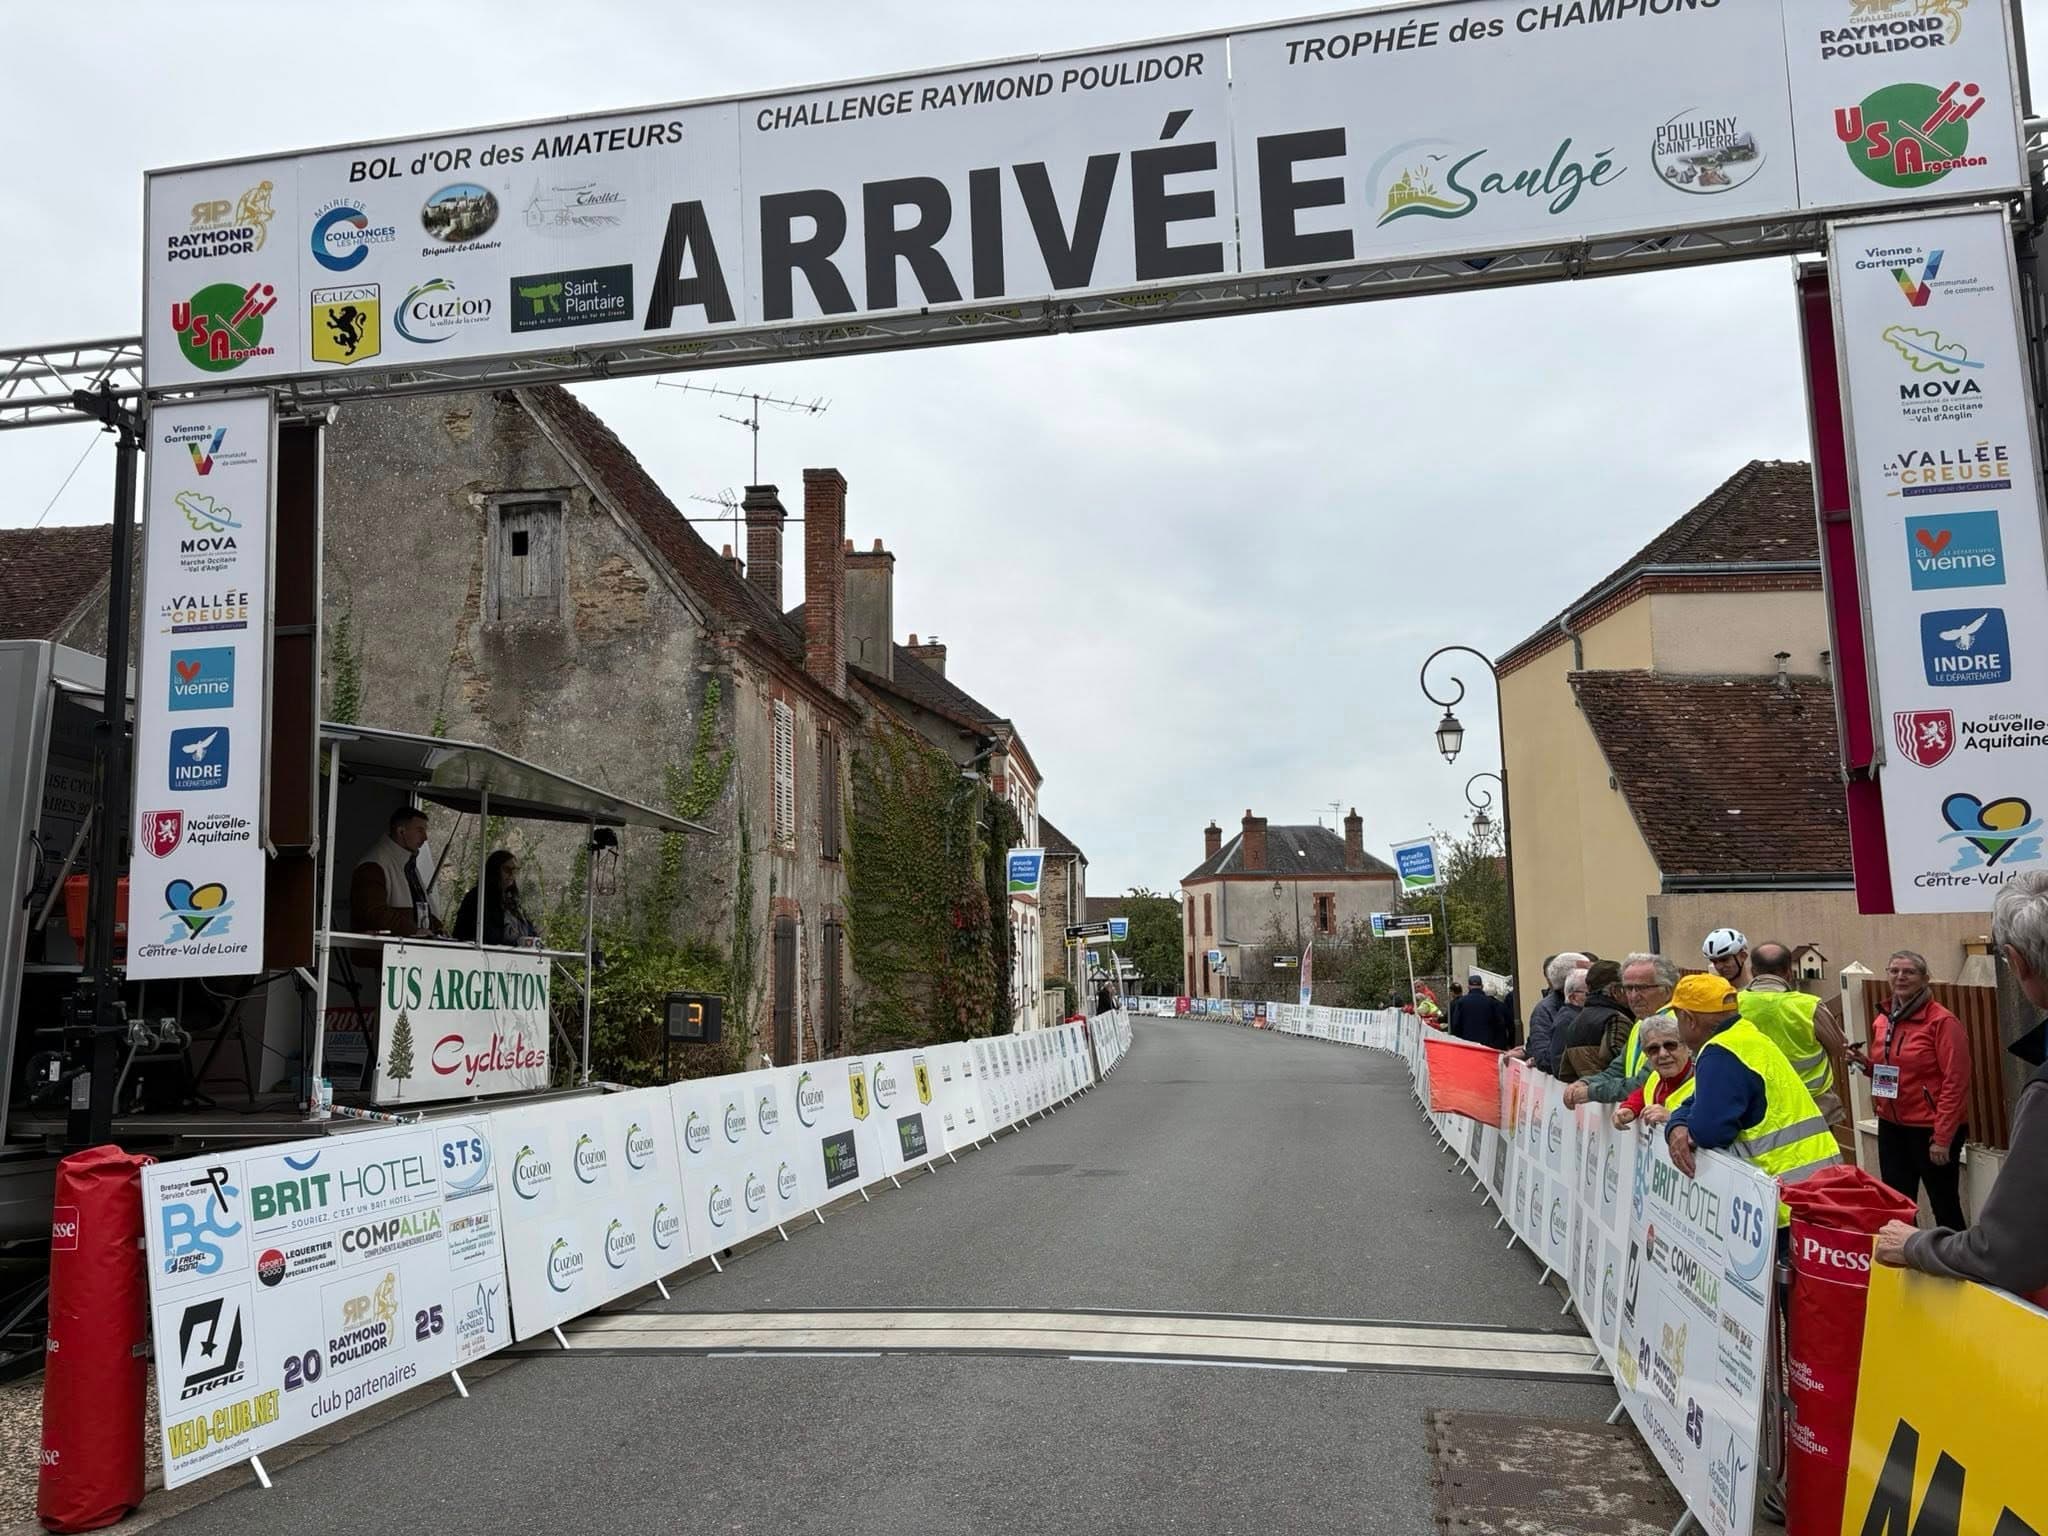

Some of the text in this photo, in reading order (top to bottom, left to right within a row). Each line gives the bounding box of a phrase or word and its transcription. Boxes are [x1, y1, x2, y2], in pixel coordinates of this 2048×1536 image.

[1285, 18, 1441, 65] TROPHÉE
[1448, 16, 1504, 44] des
[1820, 17, 1944, 44] RAYMOND
[1821, 34, 1945, 60] POULIDOR
[756, 52, 1204, 132] CHALLENGE RAYMOND POULIDOR
[1655, 116, 1738, 143] POULIGNY
[349, 120, 684, 183] BOL d'OR des AMATEURS
[1656, 131, 1740, 156] SAINT-PIERRE
[1445, 136, 1628, 220] Saulgé
[313, 197, 350, 219] MAIRIE
[643, 109, 1355, 331] ARRIVÉE
[168, 227, 255, 249] RAYMOND
[325, 226, 396, 243] COULONGES
[168, 242, 255, 263] POULIDOR
[1865, 246, 1912, 258] Vienne
[1855, 255, 1924, 271] Gartempe
[313, 285, 377, 305] ÉGUZON
[564, 280, 600, 297] Saint
[413, 296, 492, 321] Cuzion
[565, 294, 626, 314] Plantaire
[1900, 378, 1982, 401] MOVA
[1903, 402, 1984, 416] Marche Occitane
[1934, 410, 1973, 423] d'Anglin
[164, 432, 213, 445] Gartempe
[172, 424, 206, 434] Vienne
[1883, 441, 2009, 471] LA VALLÉE
[1900, 462, 2011, 485] CREUSE
[180, 536, 238, 553] MOVA
[1915, 547, 1928, 558] la
[1916, 553, 1997, 572] vienne
[171, 589, 249, 610] VALLÉE
[172, 607, 249, 623] CREUSE
[1934, 653, 2002, 673] INDRE
[1935, 670, 2002, 683] LE DÉPARTEMENT
[174, 681, 230, 696] vienne
[175, 764, 223, 780] INDRE
[186, 816, 252, 832] Nouvelle-
[186, 829, 251, 847] Aquitaine
[1913, 870, 2003, 888] Centre-Val
[138, 943, 248, 959] Centre-Val de Loire
[387, 965, 548, 1012] US ARGENTON
[431, 1031, 546, 1086] Cyclistes
[519, 1160, 552, 1181] Cuzion
[160, 1181, 190, 1193] Bretagne
[251, 1173, 331, 1223] BRIT
[340, 1155, 437, 1203] HOTEL
[1652, 1157, 1680, 1207] BRIT
[160, 1186, 208, 1201] Service Course
[357, 1205, 368, 1214] UN
[371, 1199, 387, 1211] BRIT
[389, 1194, 412, 1206] HOTEL
[285, 1240, 333, 1260] LEQUERTIER
[1803, 1236, 1872, 1272] Press
[552, 1250, 584, 1274] Cuzion
[415, 1303, 445, 1343] 25
[329, 1321, 388, 1353] RAYMOND
[329, 1336, 389, 1370] POULIDOR
[283, 1348, 324, 1394] 20
[180, 1370, 246, 1401] DRAG
[310, 1360, 418, 1419] club partenaires
[168, 1388, 281, 1461] VELO-CLUB.NET
